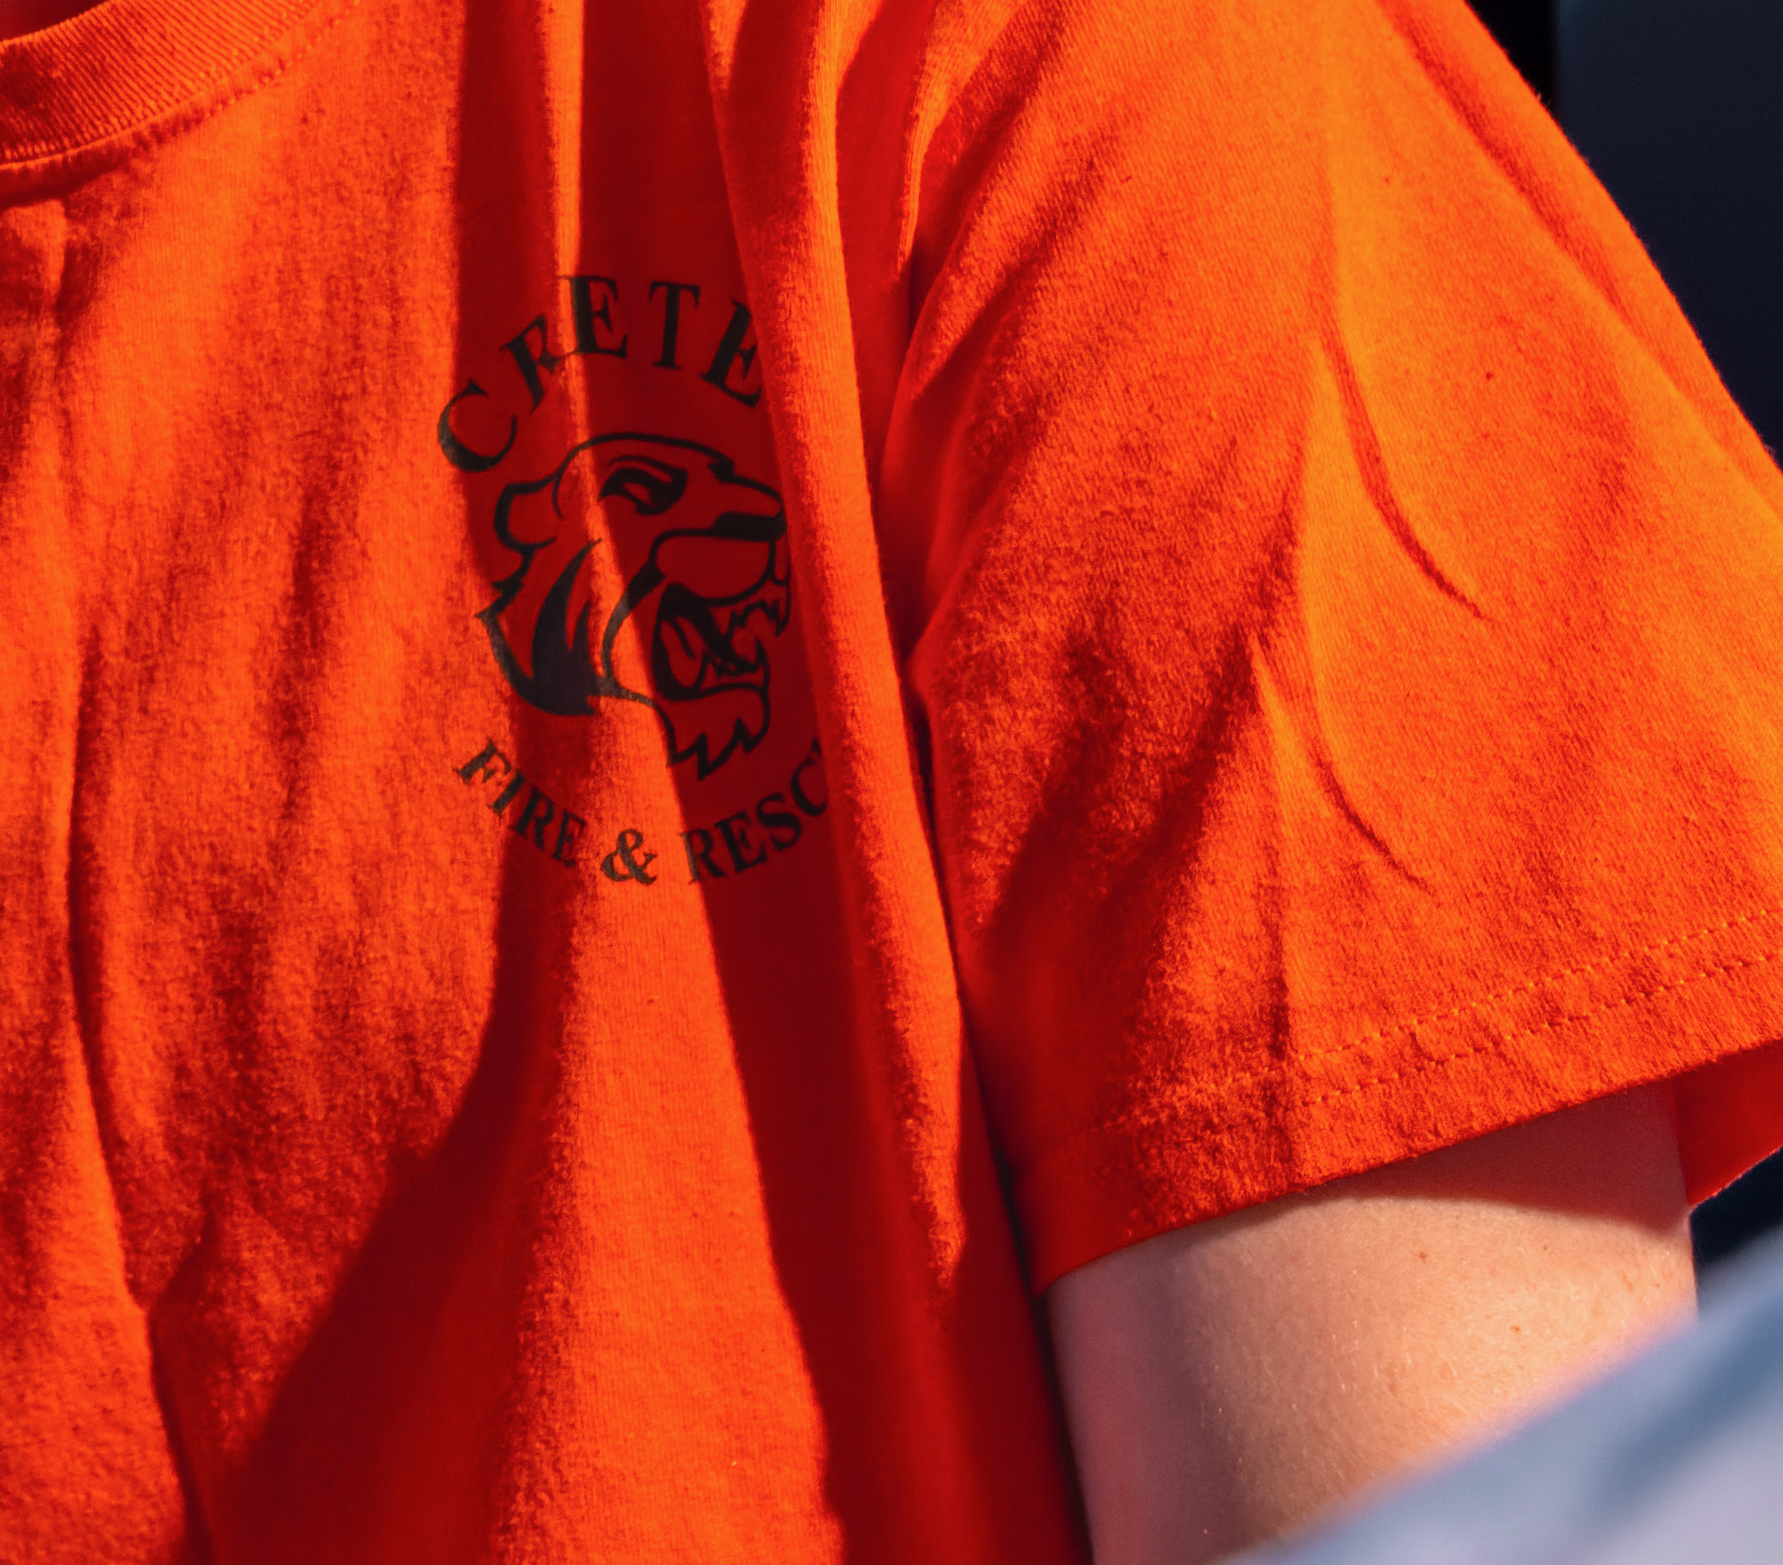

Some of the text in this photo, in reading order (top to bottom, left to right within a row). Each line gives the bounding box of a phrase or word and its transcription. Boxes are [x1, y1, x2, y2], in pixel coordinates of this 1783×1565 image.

[437, 274, 762, 473] CRETE
[453, 738, 828, 886] FIRE & RESC
